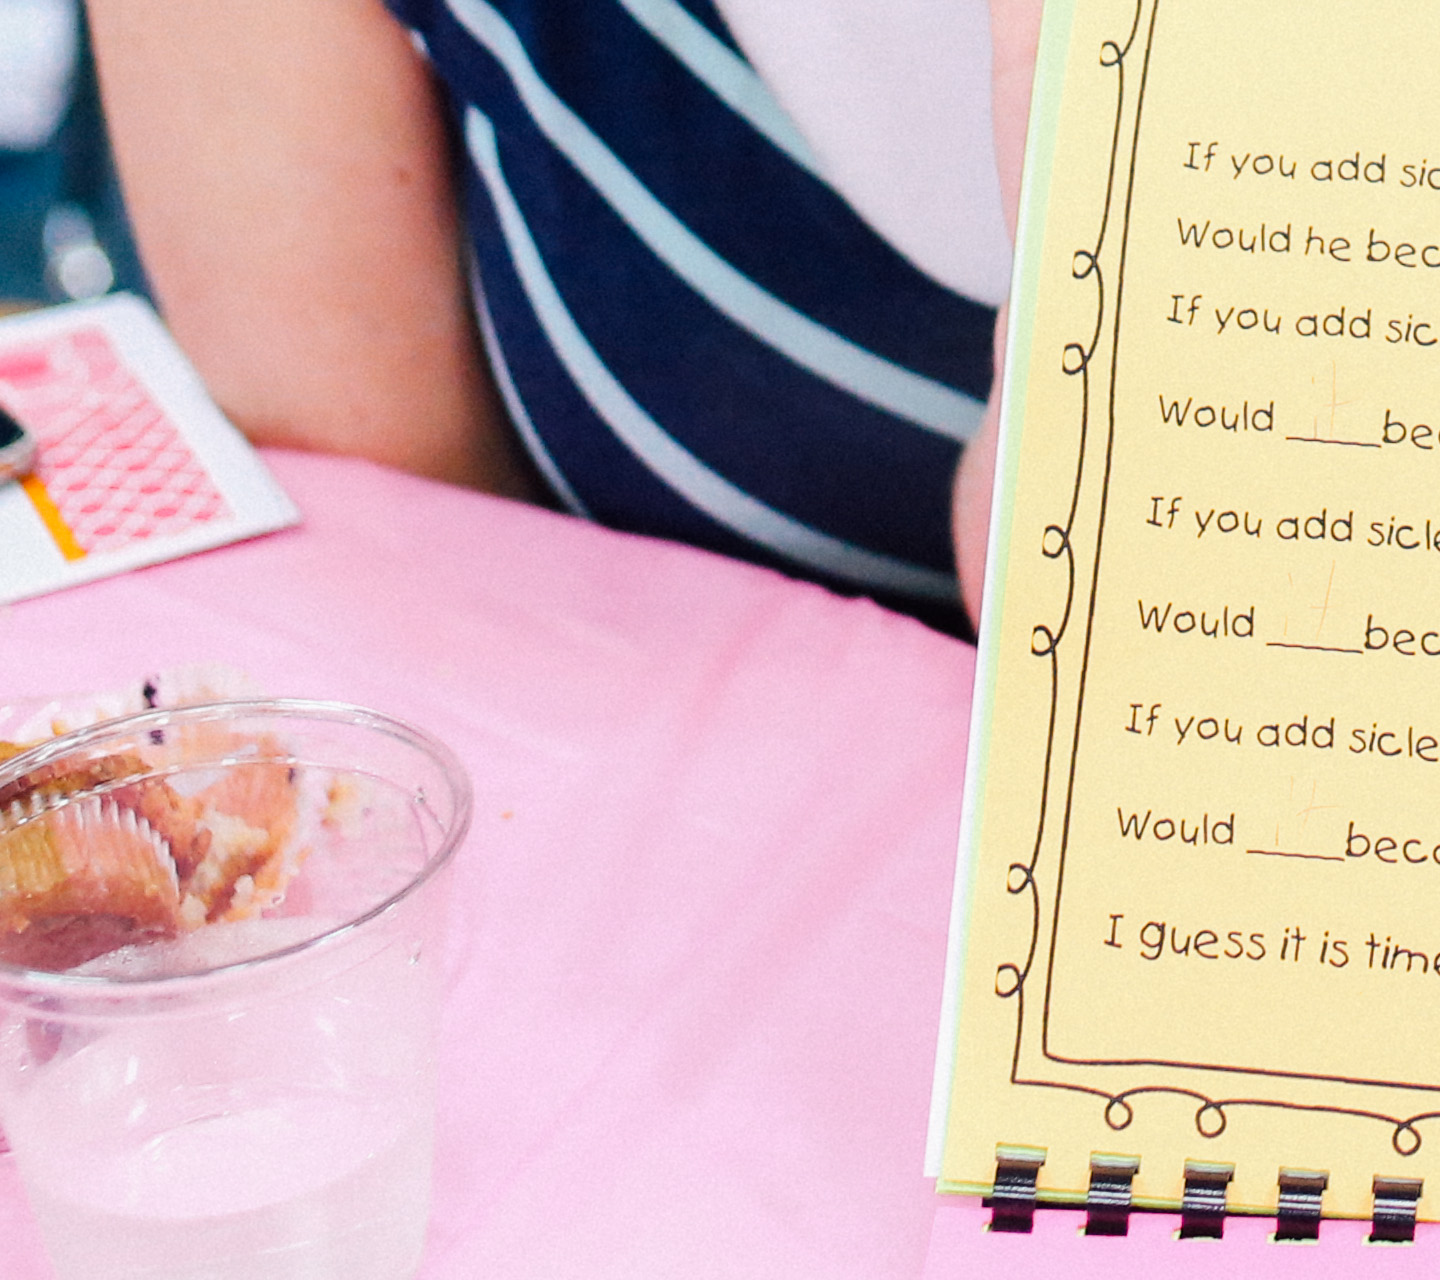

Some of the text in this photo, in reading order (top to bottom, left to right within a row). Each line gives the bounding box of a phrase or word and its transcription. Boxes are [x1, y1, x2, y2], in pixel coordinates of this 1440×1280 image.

[1182, 140, 1220, 173] If
[1229, 152, 1298, 181] you
[1309, 150, 1388, 185] add
[1176, 216, 1293, 255] Would
[1303, 224, 1353, 264] he
[1165, 293, 1204, 327] If
[1213, 305, 1283, 336] you
[1294, 305, 1373, 340] add
[1157, 393, 1276, 434] Would
[1144, 495, 1184, 530] If
[1193, 507, 1264, 540] you
[1275, 506, 1355, 544] add
[1136, 598, 1256, 640] Would
[1123, 702, 1163, 738] If
[1173, 715, 1244, 747] you
[1255, 713, 1337, 750] add
[1347, 721, 1440, 764] sicle
[1115, 806, 1237, 848] Would
[1102, 912, 1126, 950] I
[1138, 919, 1268, 962] guess
[1278, 925, 1308, 963] it
[1318, 929, 1351, 970] is
